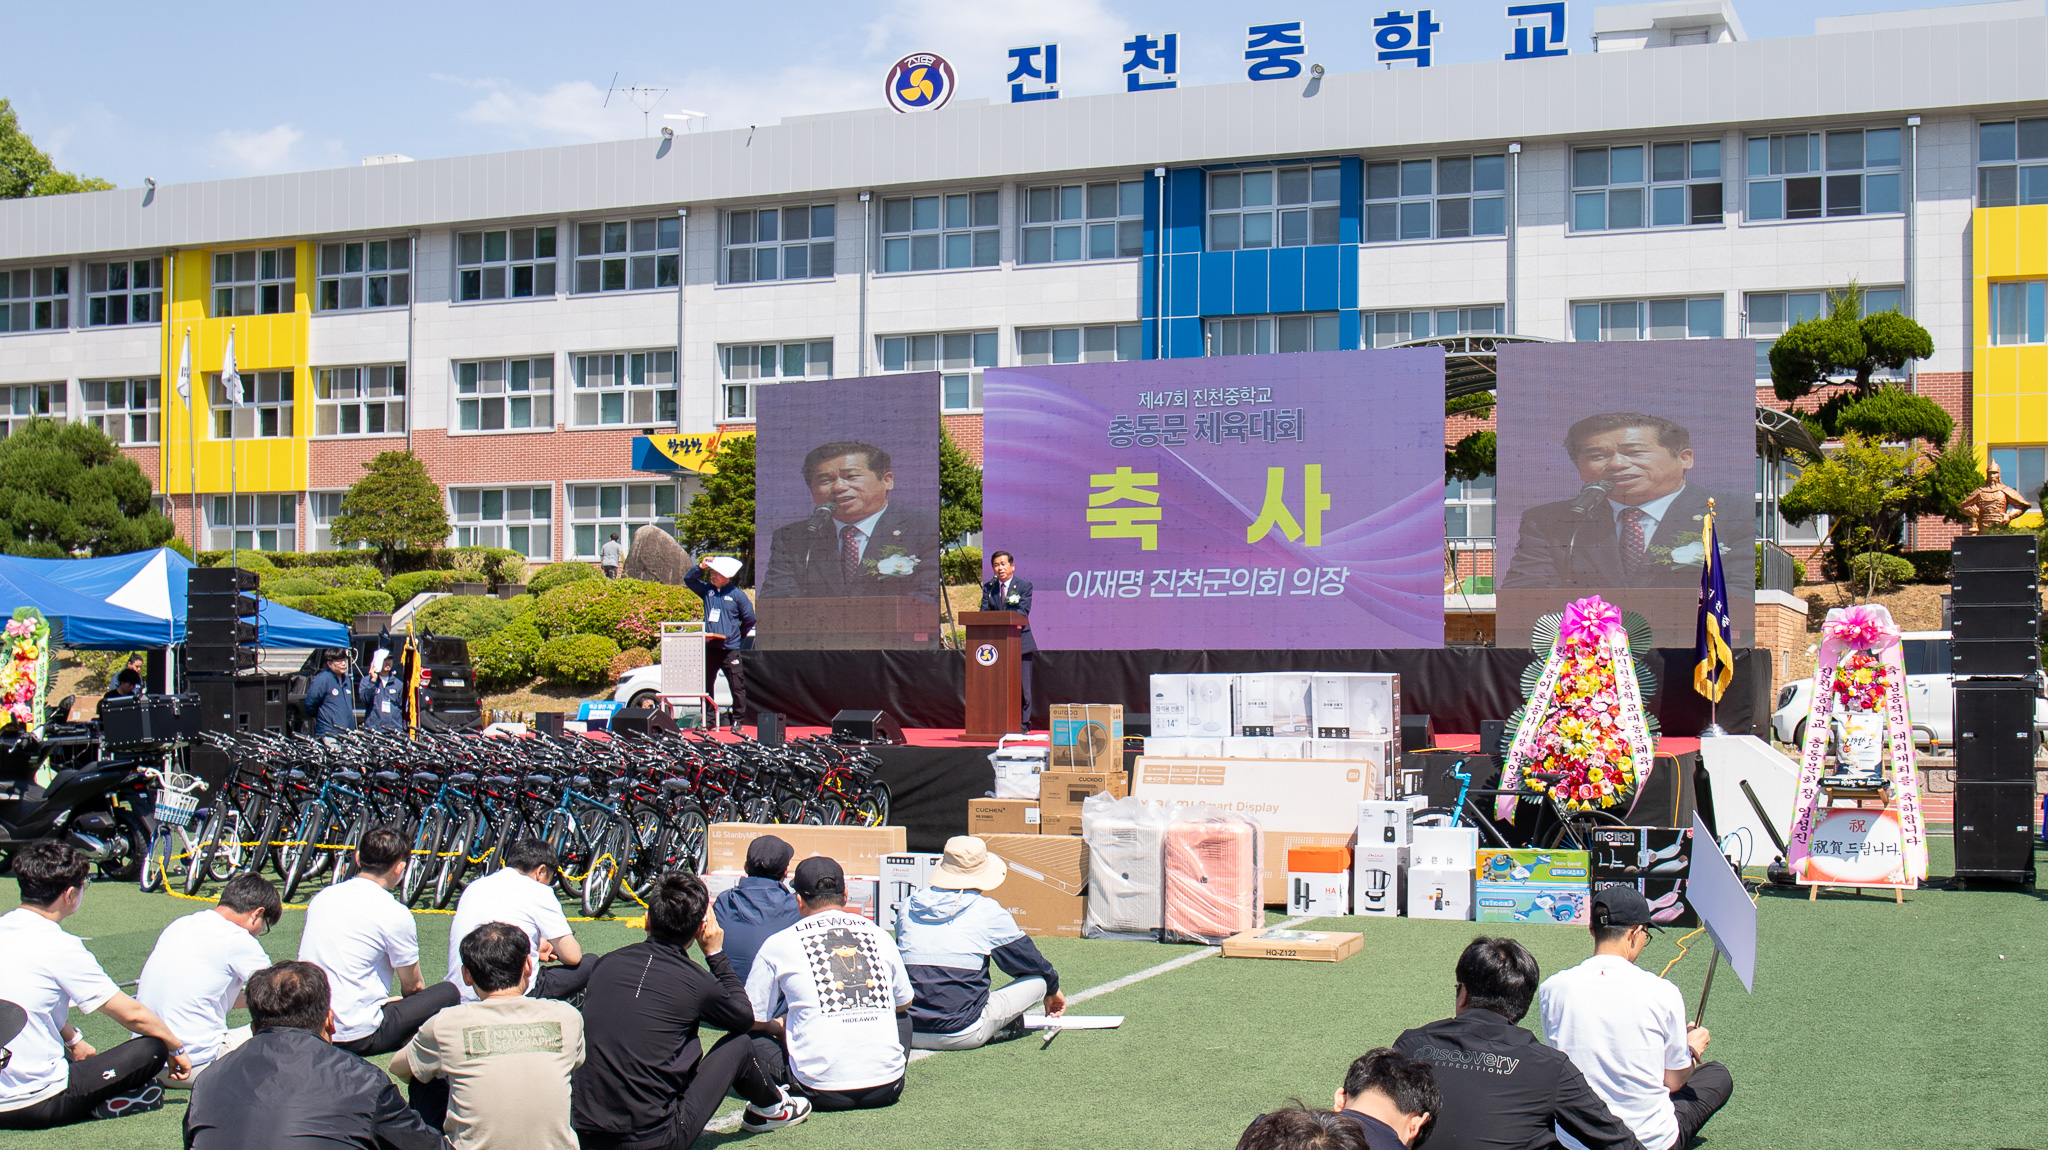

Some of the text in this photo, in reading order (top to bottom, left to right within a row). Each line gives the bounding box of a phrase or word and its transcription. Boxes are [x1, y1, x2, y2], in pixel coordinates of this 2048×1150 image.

[1138, 386, 1273, 409] 제47회 진천중학교
[1108, 407, 1304, 448] 총동문 체육대회
[668, 438, 702, 454] 찬란한
[1065, 567, 1350, 599] 이재명 진천군의회 의장
[1236, 801, 1279, 814] Display
[1794, 806, 1812, 844] 임성진
[1849, 818, 1867, 834] 祝
[723, 831, 757, 839] StanbyME
[1813, 840, 1901, 857] 祝賀 드립니다.
[1325, 887, 1337, 895] HA
[1265, 948, 1297, 957] HQ-Z122
[493, 1027, 546, 1040] NATIONAL
[493, 1036, 562, 1048] GEOGRAPHIC
[1434, 1061, 1503, 1075] EXPEDITION
